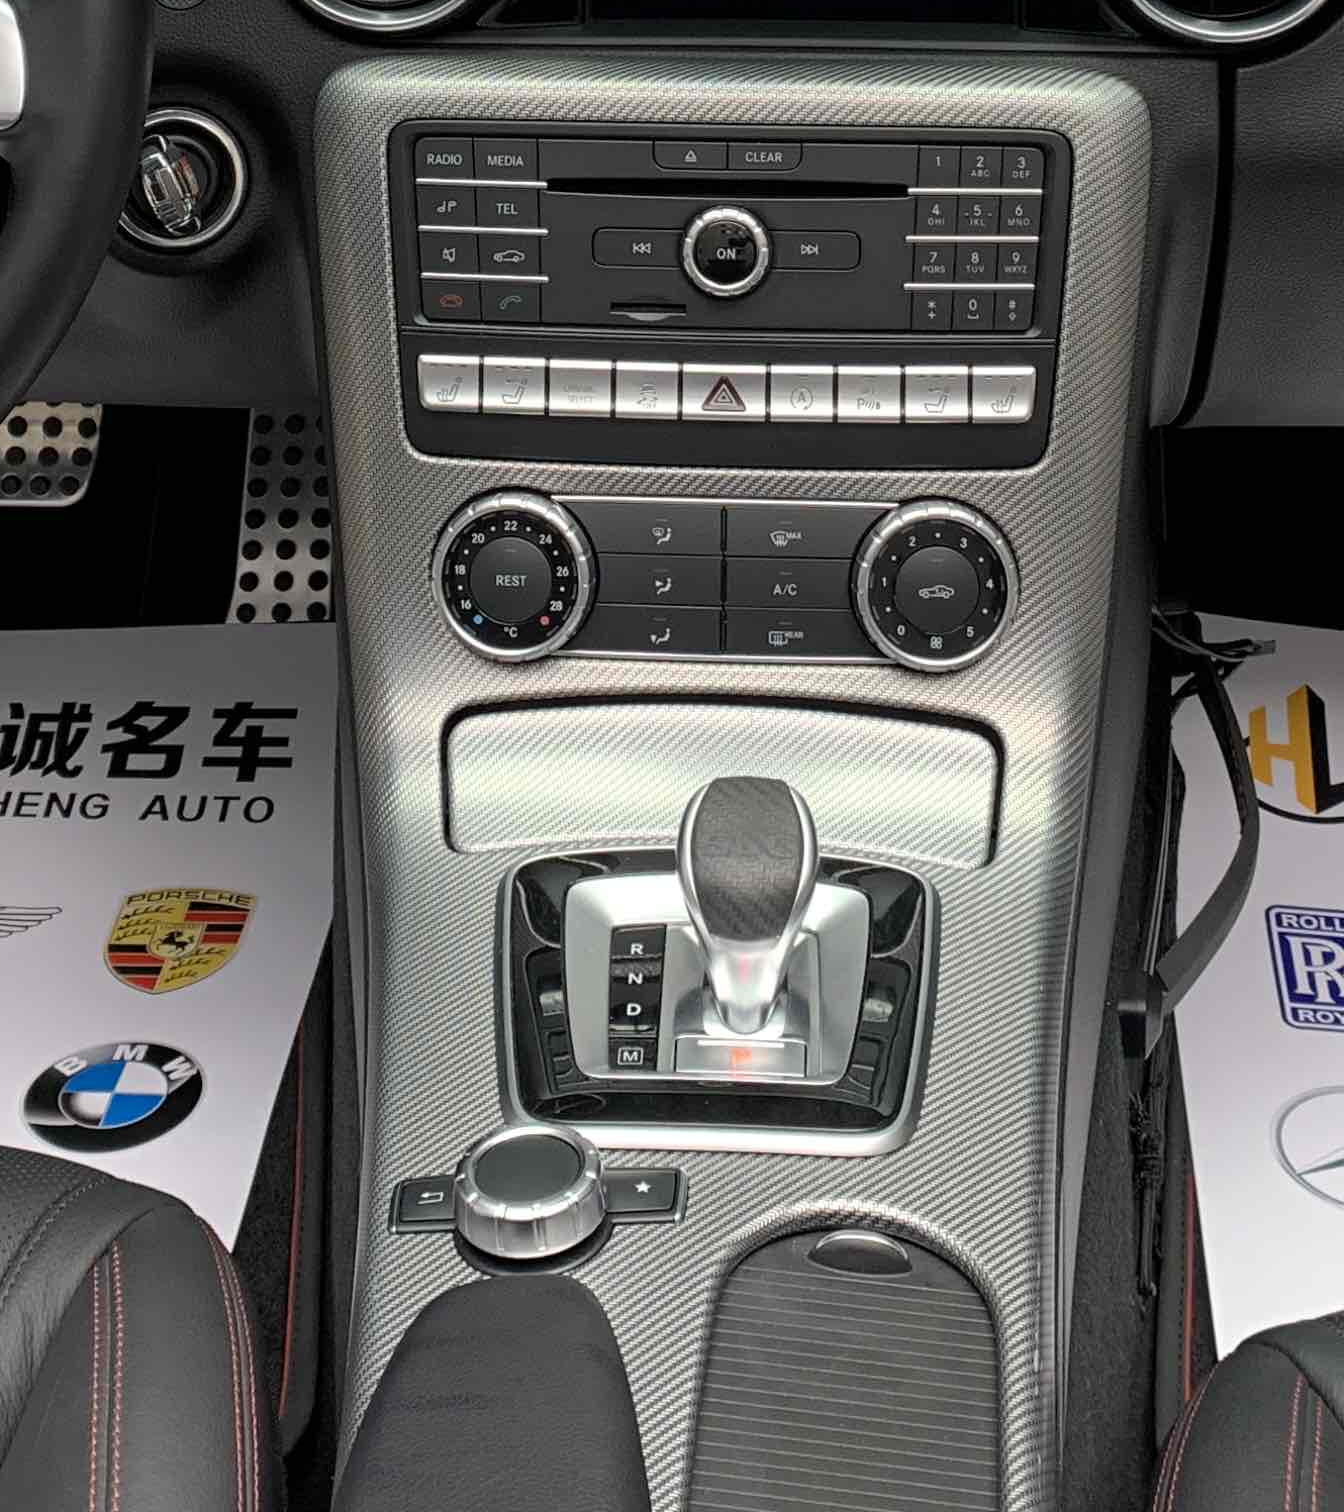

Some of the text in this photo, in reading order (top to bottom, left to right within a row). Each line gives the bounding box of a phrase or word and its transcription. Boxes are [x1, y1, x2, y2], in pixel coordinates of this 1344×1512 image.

[426, 153, 463, 166] RADIO
[487, 155, 524, 167] MEDIA
[745, 151, 783, 163] CLEAR
[936, 155, 941, 166] 1
[976, 155, 984, 168] 2
[1017, 156, 1026, 168] 3
[496, 203, 518, 215] TEL
[932, 204, 940, 215] 4
[973, 204, 981, 216] 5
[1015, 205, 1023, 216] 6
[716, 247, 737, 260] ON
[929, 251, 938, 263] 7
[971, 251, 980, 263] 8
[1012, 252, 1020, 264] 9
[968, 299, 977, 310] 0
[504, 520, 518, 531] 22
[471, 533, 485, 544] 20
[539, 534, 553, 545] 24
[908, 536, 916, 547] 2
[960, 537, 968, 549] 3
[455, 564, 466, 575] 18
[556, 566, 569, 577] 26
[495, 574, 528, 587] REST
[882, 576, 887, 587] 1
[986, 578, 995, 590] 4
[773, 583, 798, 596] A/C
[460, 599, 472, 610] 16
[550, 600, 563, 611] 28
[897, 625, 905, 636] 0
[966, 626, 974, 637] 5
[138, 793, 275, 824] AUTO
[127, 889, 252, 906] PORSCHE
[630, 943, 644, 955] R
[628, 972, 643, 985] N
[626, 1002, 641, 1016] D
[53, 1044, 198, 1080] BMW
